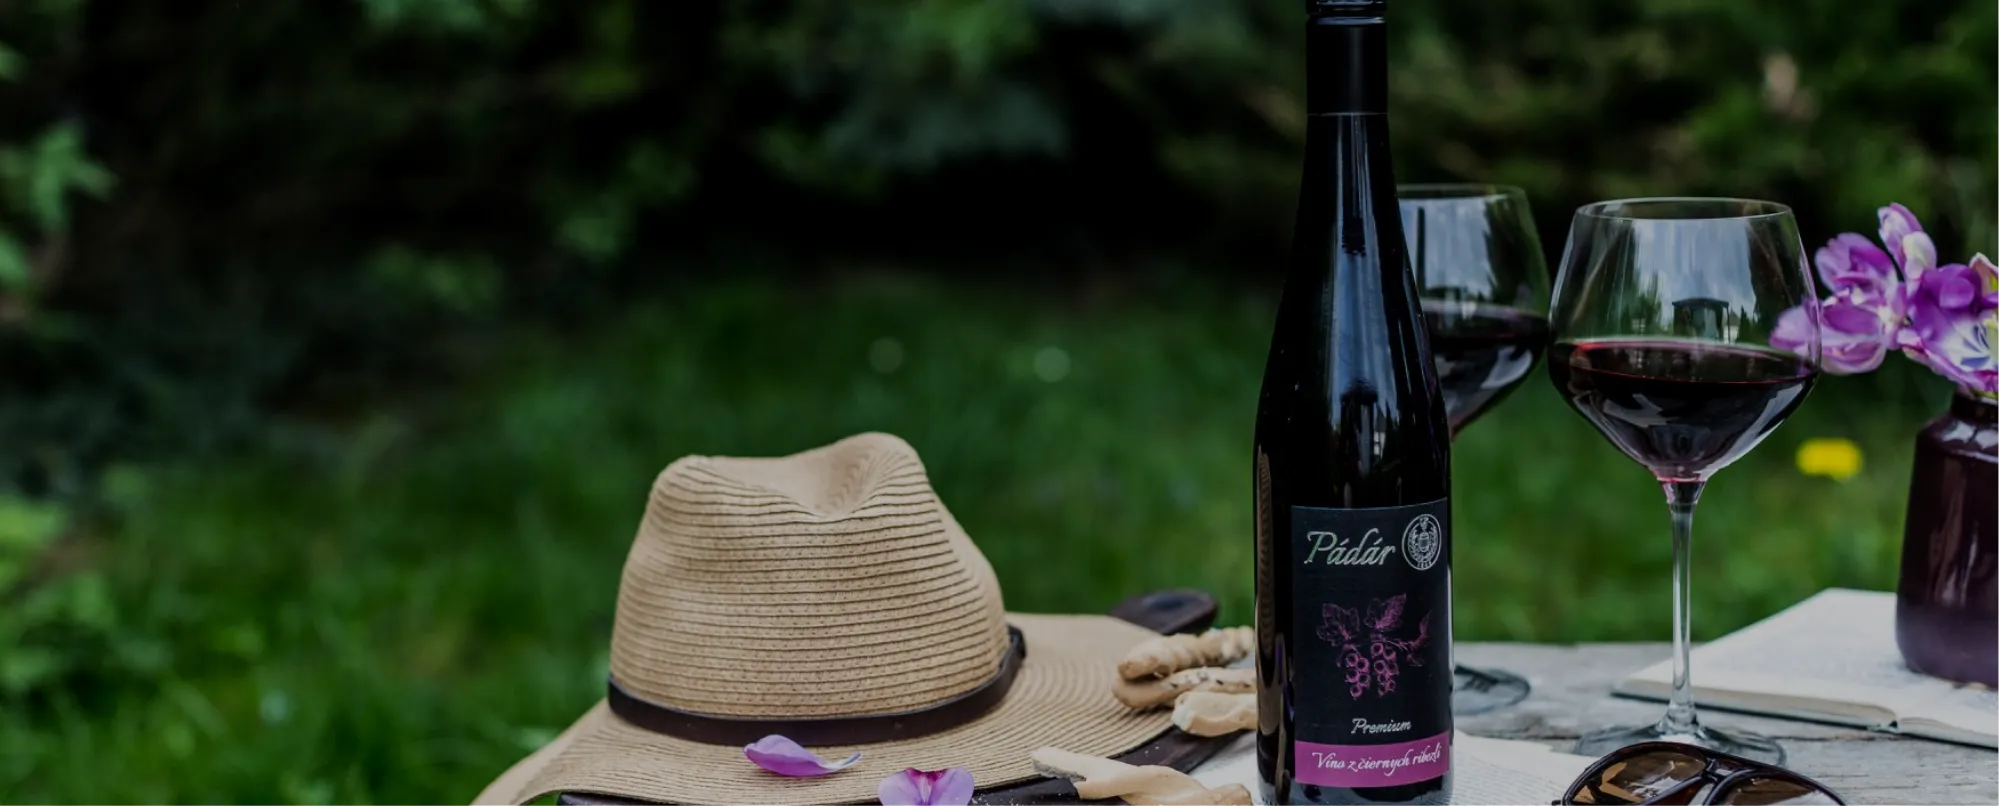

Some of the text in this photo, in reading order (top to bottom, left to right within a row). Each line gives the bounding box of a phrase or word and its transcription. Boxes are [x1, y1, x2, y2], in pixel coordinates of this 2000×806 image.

[1304, 527, 1396, 565] Pádár
[1351, 718, 1411, 734] Premium
[1347, 761, 1358, 772] z
